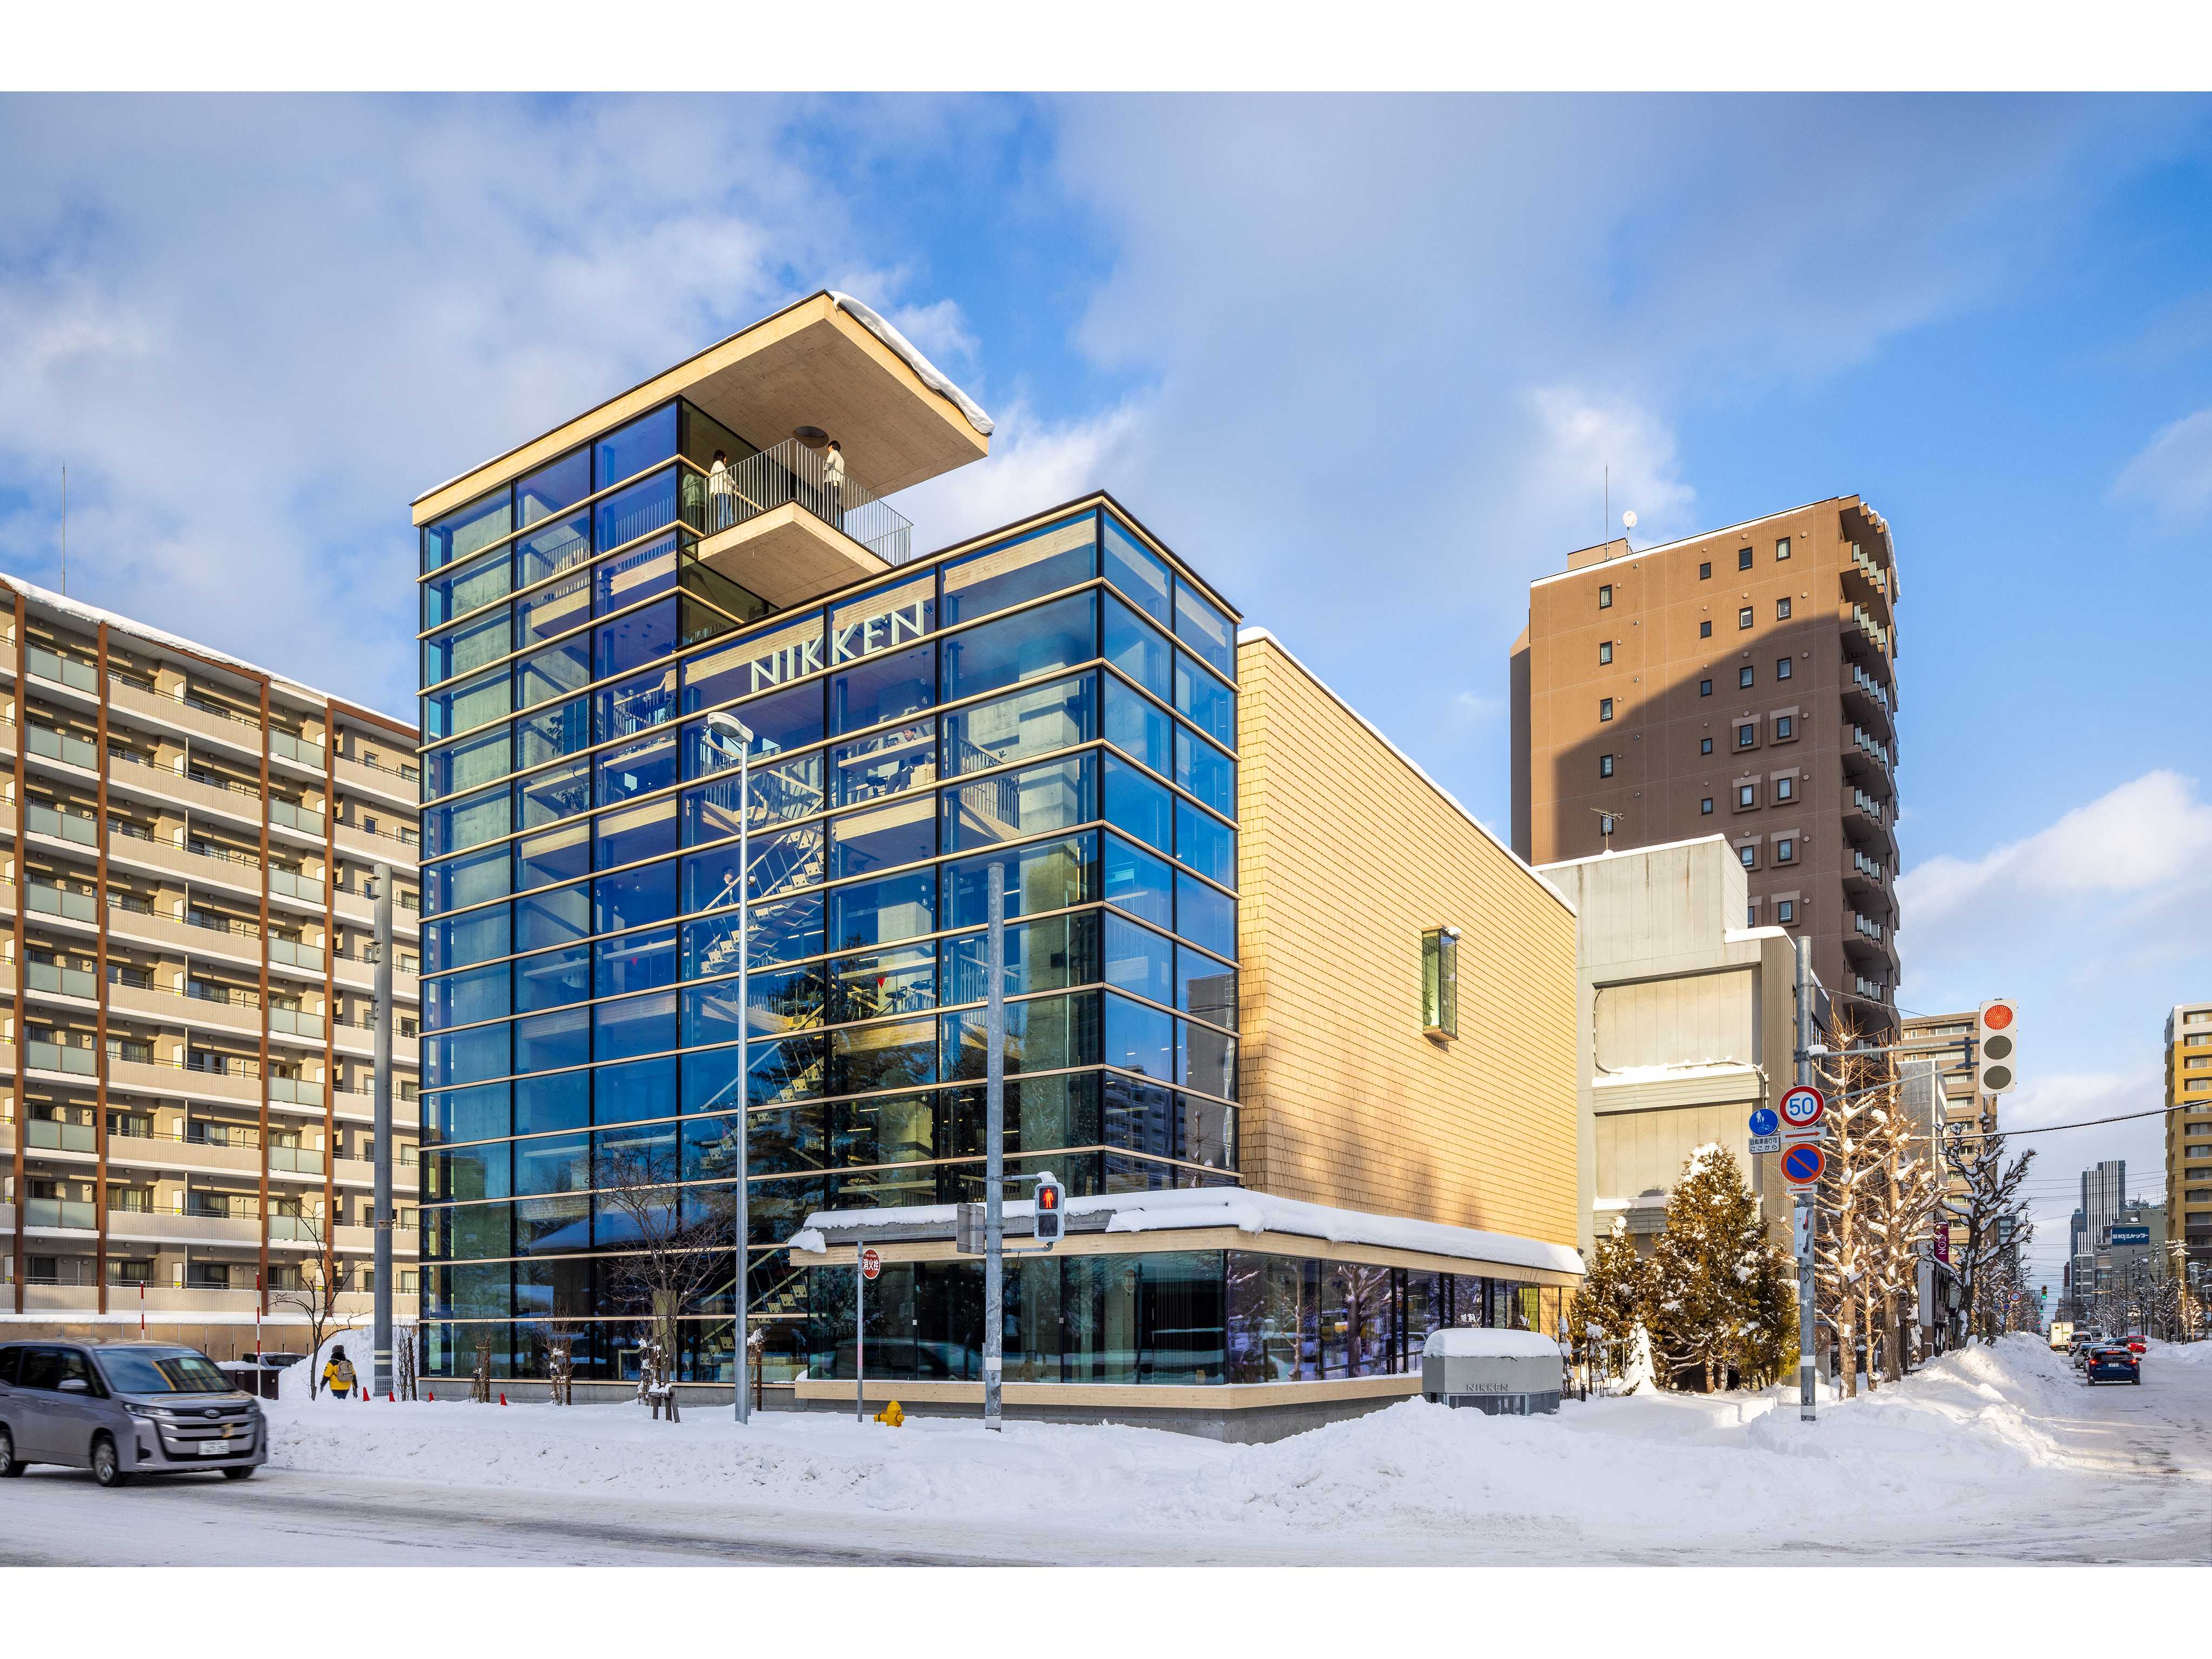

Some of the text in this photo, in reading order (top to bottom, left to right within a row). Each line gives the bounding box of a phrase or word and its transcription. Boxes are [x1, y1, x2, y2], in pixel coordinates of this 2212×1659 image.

[751, 600, 924, 692] NIKKEN
[1789, 1097, 1814, 1116] 50
[1750, 1137, 1777, 1145] 自転車通行可
[863, 1258, 879, 1270] 消火栓
[1467, 1383, 1509, 1392] NIKKEN
